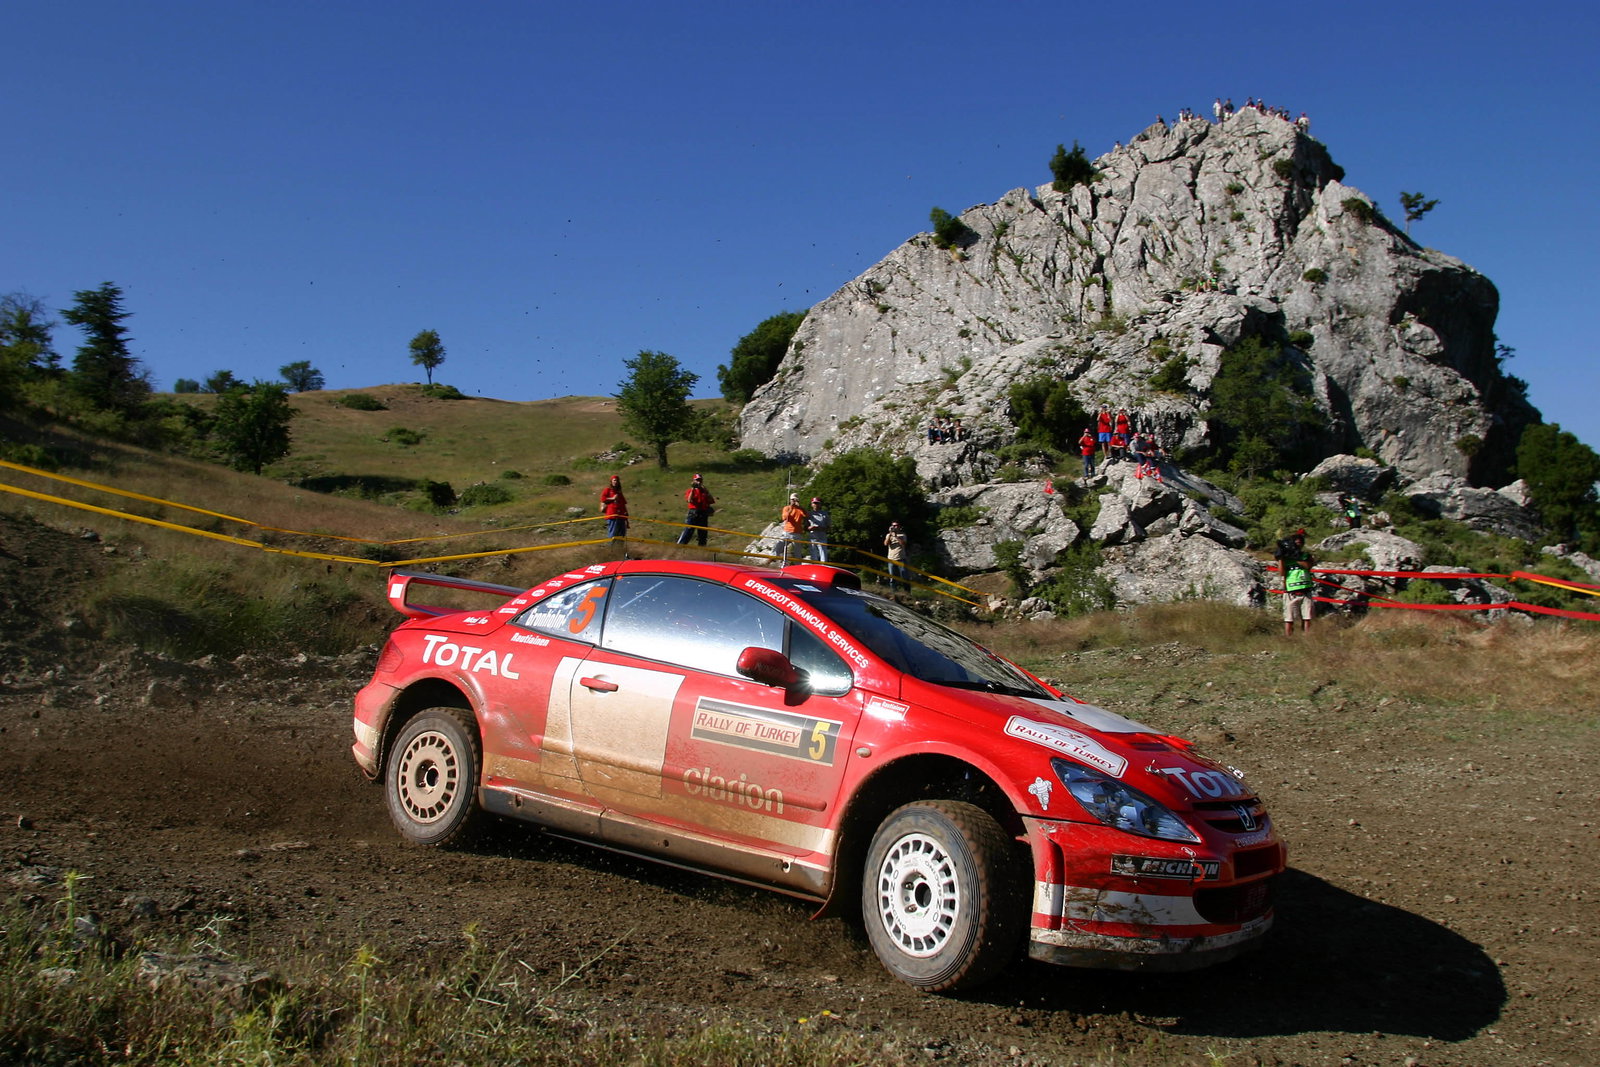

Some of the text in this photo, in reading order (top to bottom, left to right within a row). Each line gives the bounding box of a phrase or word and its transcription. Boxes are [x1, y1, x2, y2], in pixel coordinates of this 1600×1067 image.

[569, 587, 608, 634] 5
[751, 581, 869, 669] PEUGEOT FINANCIAL SERVICES
[422, 634, 520, 680] TOTAL
[697, 712, 800, 743] RALLY OF TURKEY
[808, 721, 831, 760] 5
[1015, 725, 1116, 769] RALLY OF TURKEY
[682, 766, 785, 815] Clarion
